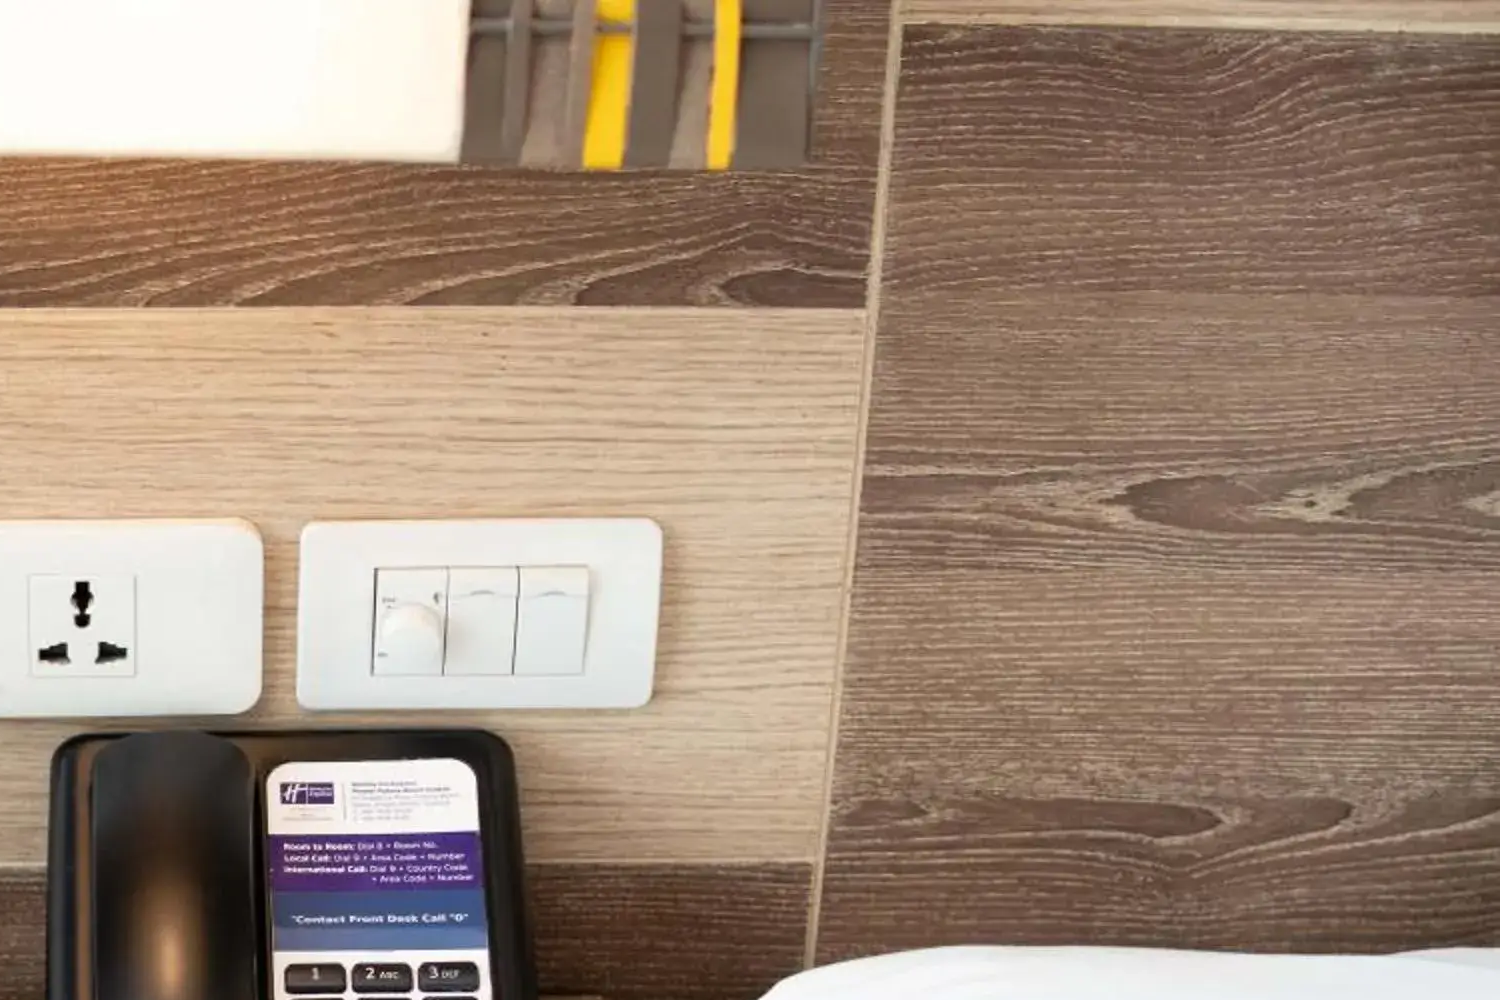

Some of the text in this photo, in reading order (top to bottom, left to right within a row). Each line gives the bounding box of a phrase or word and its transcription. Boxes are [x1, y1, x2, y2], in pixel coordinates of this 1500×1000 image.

[350, 914, 384, 923] Front
[388, 913, 418, 923] Desk
[422, 913, 447, 923] Call
[311, 968, 320, 980] 1
[365, 968, 399, 979] 2 ABC
[429, 966, 439, 979] 3
